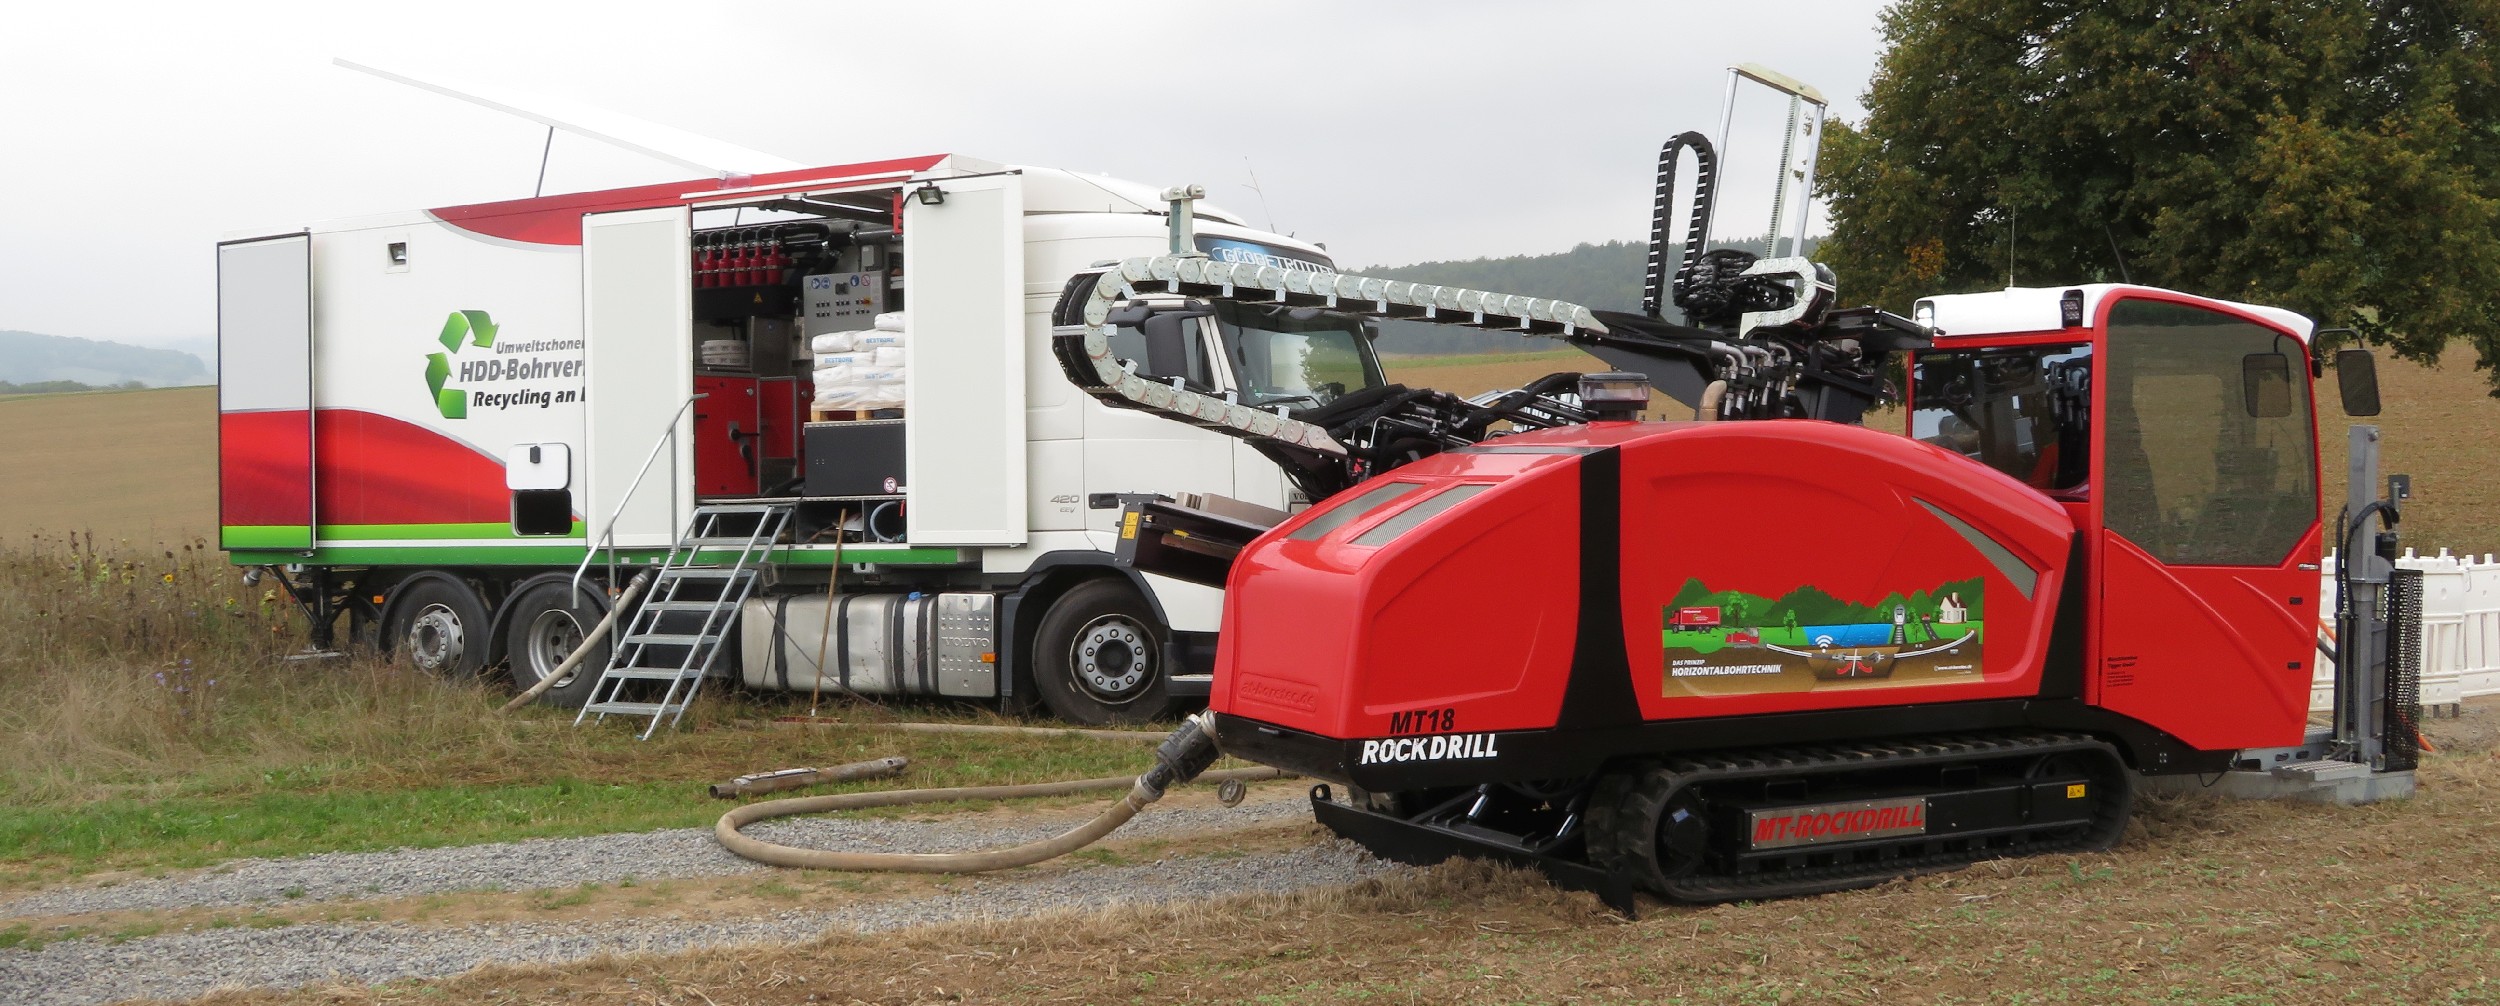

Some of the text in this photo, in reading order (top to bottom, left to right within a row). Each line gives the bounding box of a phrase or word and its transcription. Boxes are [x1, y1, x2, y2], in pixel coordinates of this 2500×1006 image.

[459, 357, 584, 383] HDD-Bohrver
[473, 389, 550, 411] Recycling
[555, 390, 576, 403] an
[1050, 495, 1080, 504] 420
[941, 636, 990, 647] VOLVO
[1672, 665, 1782, 676] HORIZONTALBOHRTECHNIK
[1389, 708, 1455, 734] MT18
[1361, 733, 1498, 765] ROCKDRILL
[1753, 805, 1924, 842] MT-ROCKDRILL
